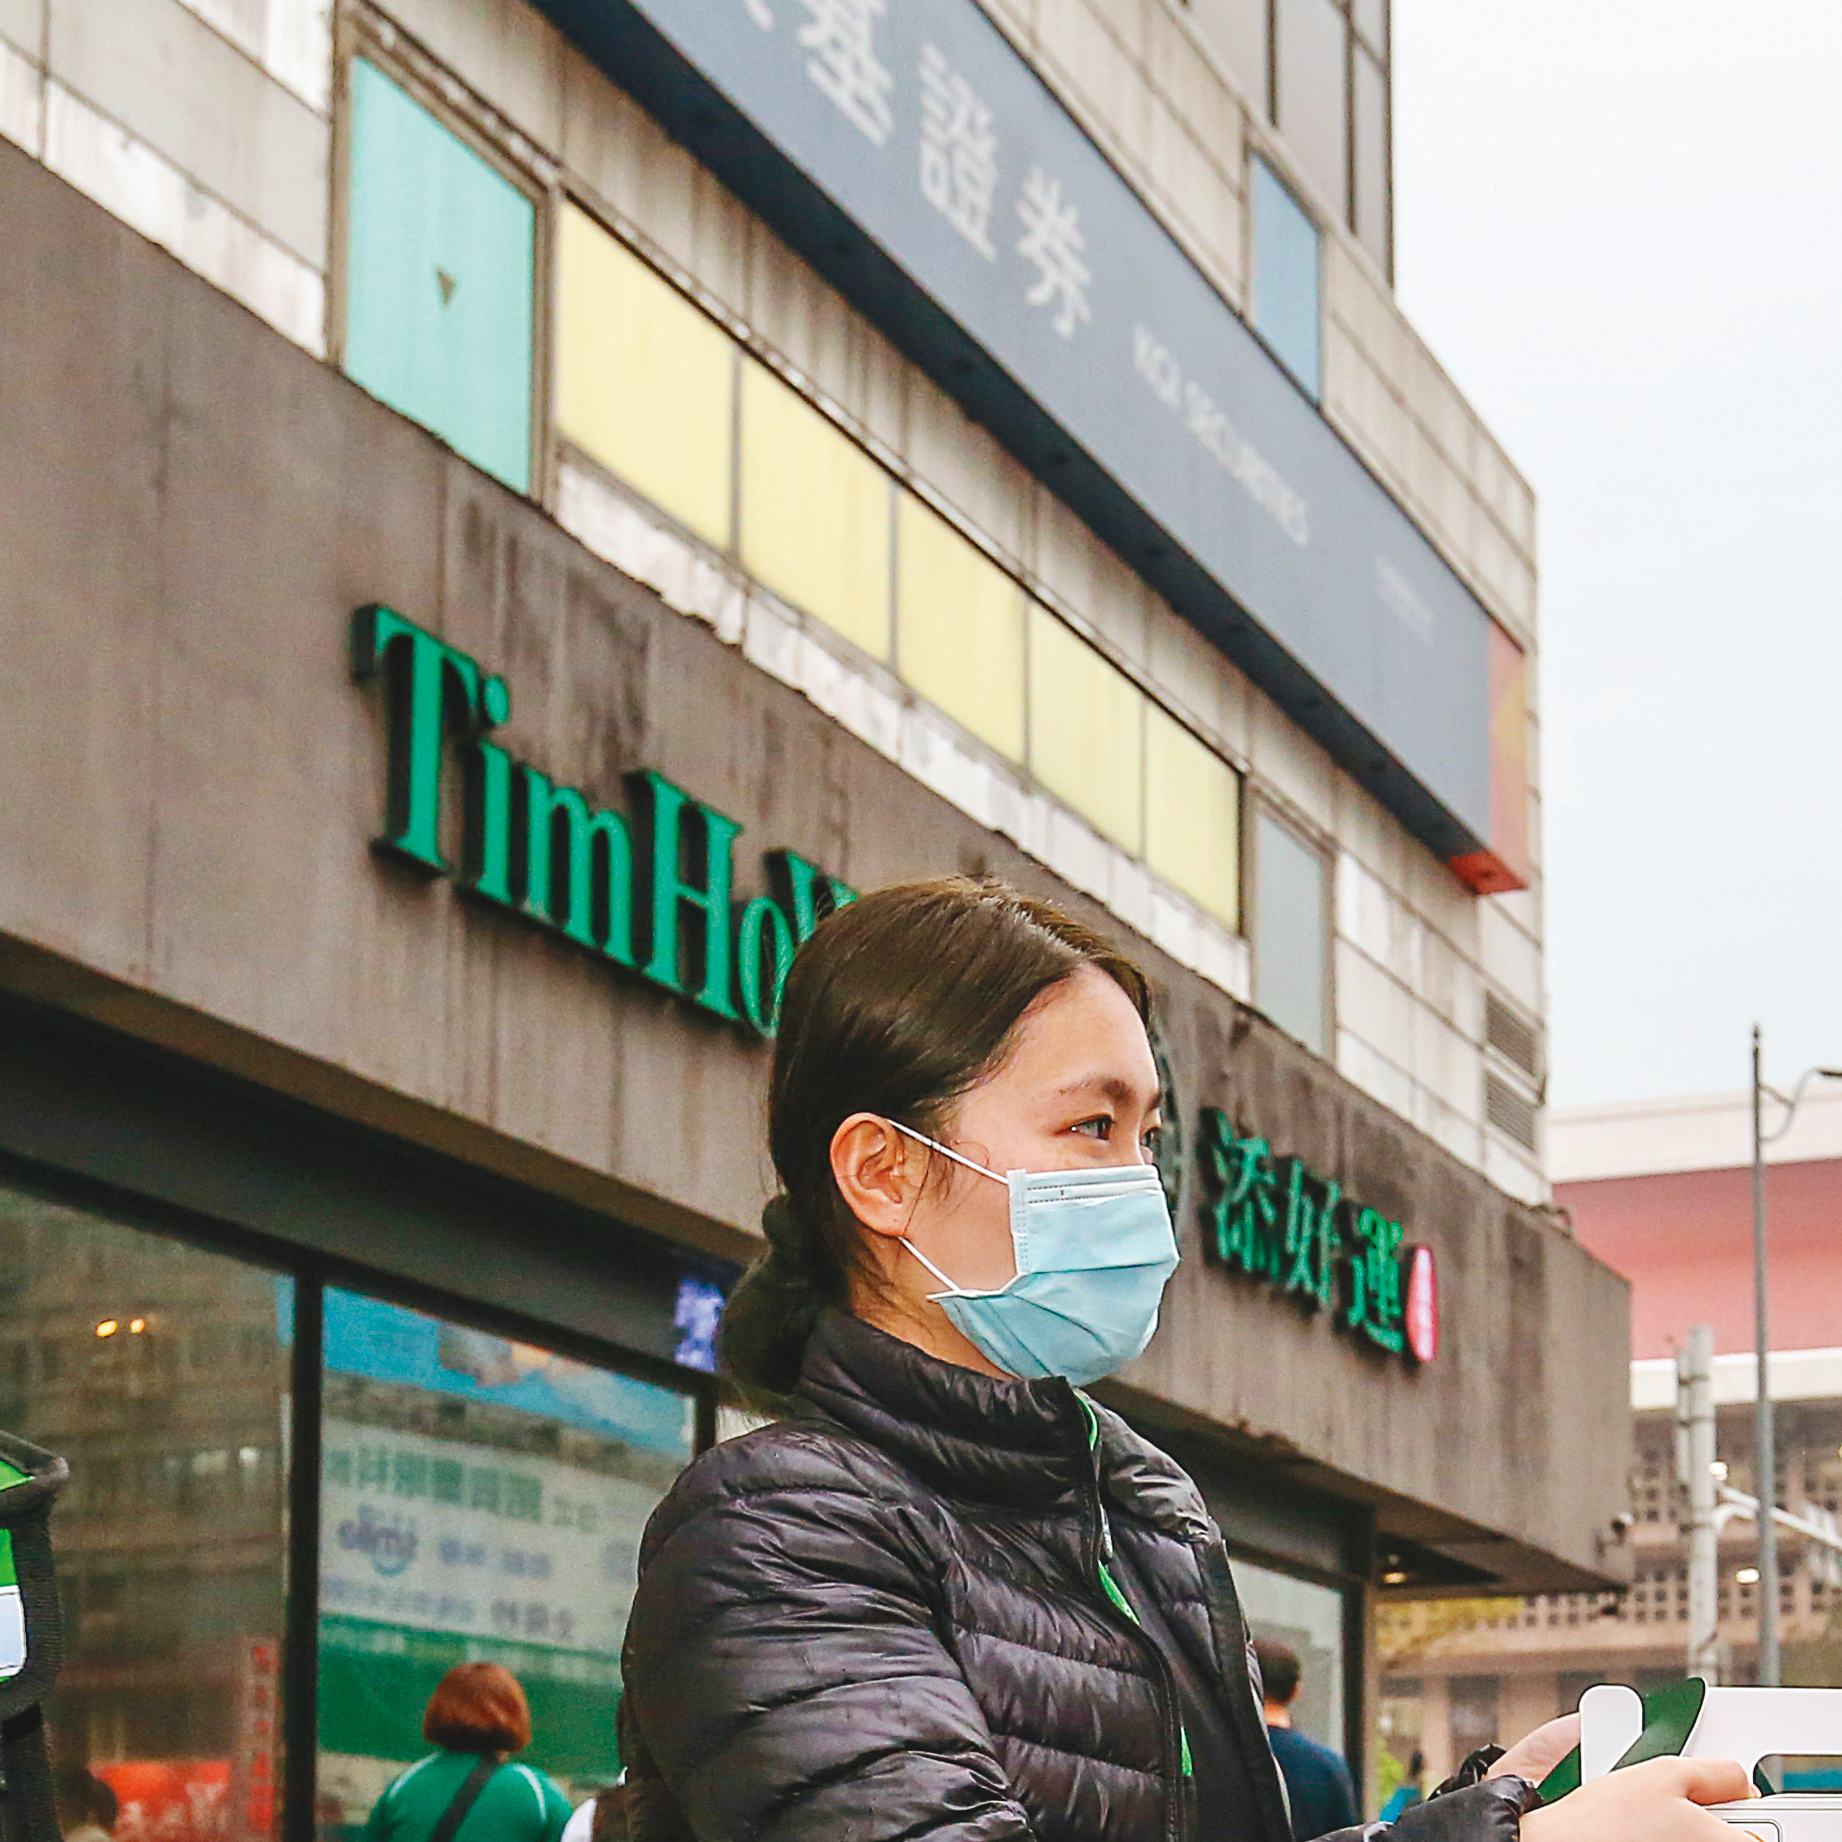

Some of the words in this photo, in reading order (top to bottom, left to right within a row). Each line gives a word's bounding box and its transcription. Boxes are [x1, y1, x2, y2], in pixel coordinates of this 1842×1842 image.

[747, 0, 1094, 340] 基證券
[1211, 1108, 1404, 1352] 添好運
